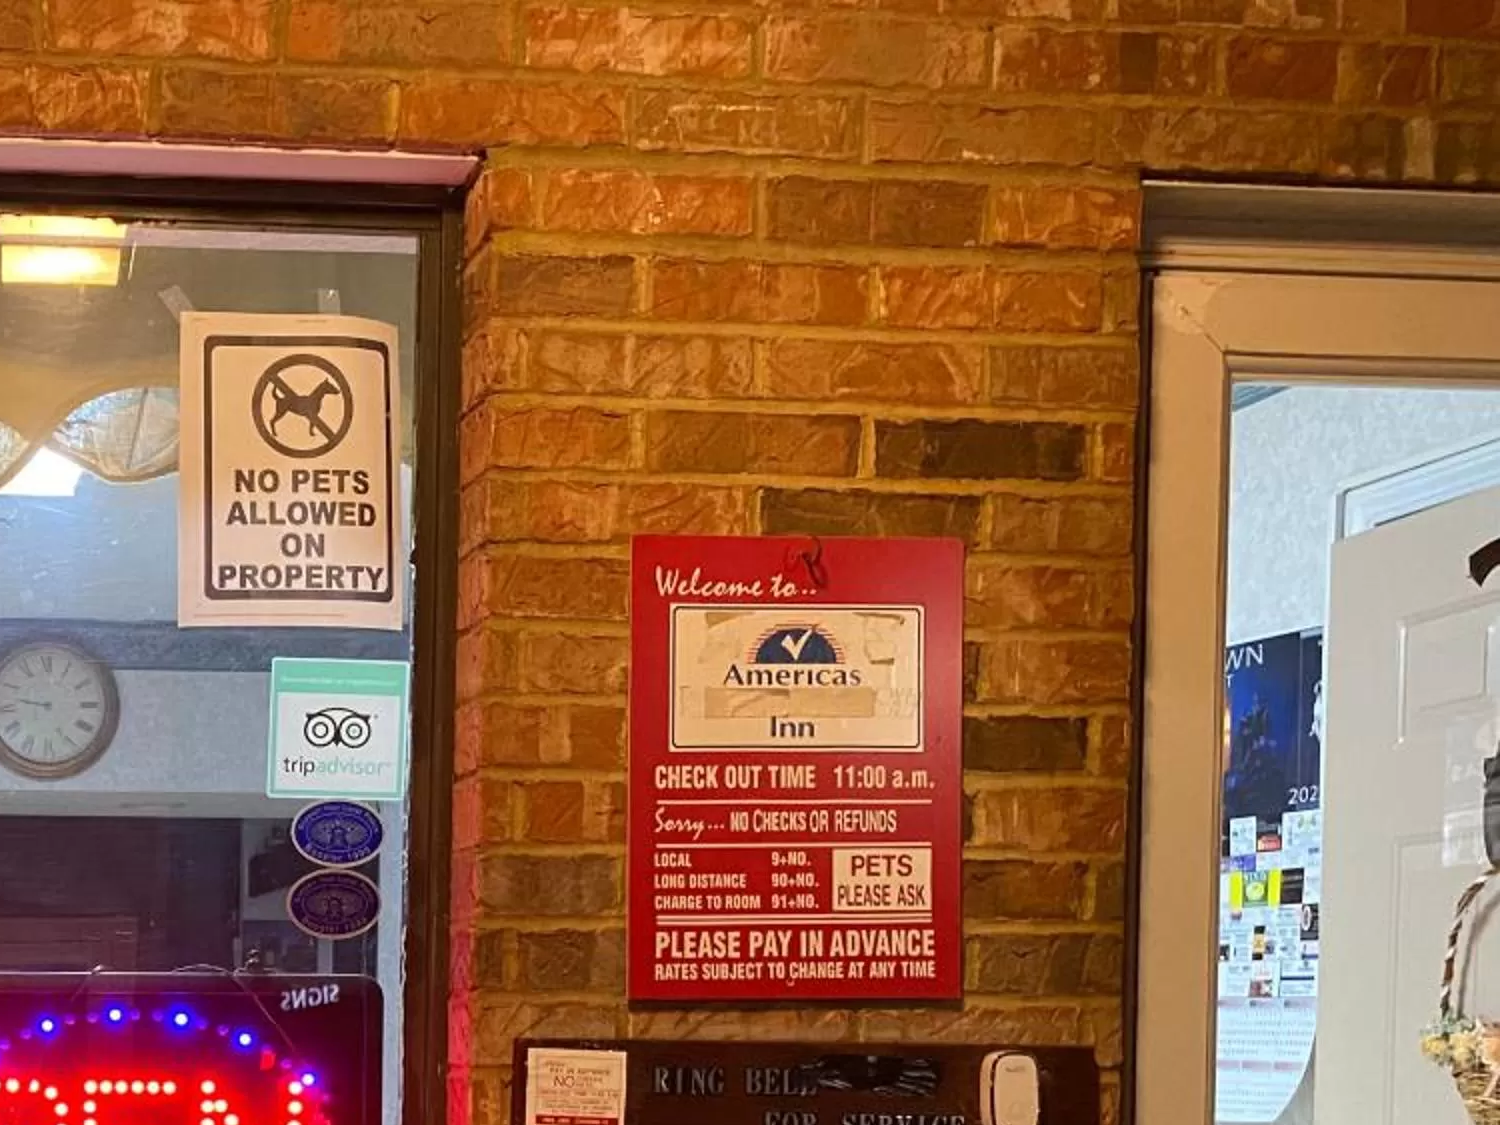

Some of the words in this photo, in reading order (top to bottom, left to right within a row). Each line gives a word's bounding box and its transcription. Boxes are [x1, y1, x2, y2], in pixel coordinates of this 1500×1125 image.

[234, 468, 280, 493] NO
[291, 469, 370, 494] PETS
[225, 501, 377, 527] ALLOWED
[280, 533, 326, 558] ON
[217, 564, 386, 590] PROPERTY
[654, 565, 764, 597] Welcome
[723, 663, 862, 687] Americas
[769, 716, 816, 738] Inn
[283, 755, 383, 777] tripadvisor
[654, 764, 719, 789] CHECK
[724, 764, 763, 789] OUT
[767, 764, 817, 789] TIME
[833, 765, 887, 789] 11:00
[891, 768, 936, 789] a.m.
[729, 810, 749, 832] NO
[752, 810, 807, 832] CHECKS
[809, 810, 829, 832] OR
[834, 809, 897, 832] REFUNDS
[654, 852, 692, 867] LOCAL
[850, 854, 913, 877] PETS
[654, 873, 686, 889] LONG
[689, 873, 747, 889] DISTANCE
[654, 895, 704, 910] CHARGE
[706, 894, 722, 910] TO
[725, 894, 761, 910] ROOM
[837, 884, 891, 907] PLEASE
[897, 884, 926, 907] ASK
[655, 931, 741, 959] PLEASE
[749, 931, 793, 958] PAY
[800, 930, 824, 957] IN
[830, 929, 936, 957] ADVANCE
[654, 962, 698, 981] RATES
[702, 962, 763, 980] SUBJECT
[767, 962, 785, 979] TO
[789, 961, 844, 980] CHANGE
[848, 961, 864, 979] AT
[869, 961, 896, 979] ANY
[901, 960, 936, 979] TIME
[653, 1066, 725, 1096] RING
